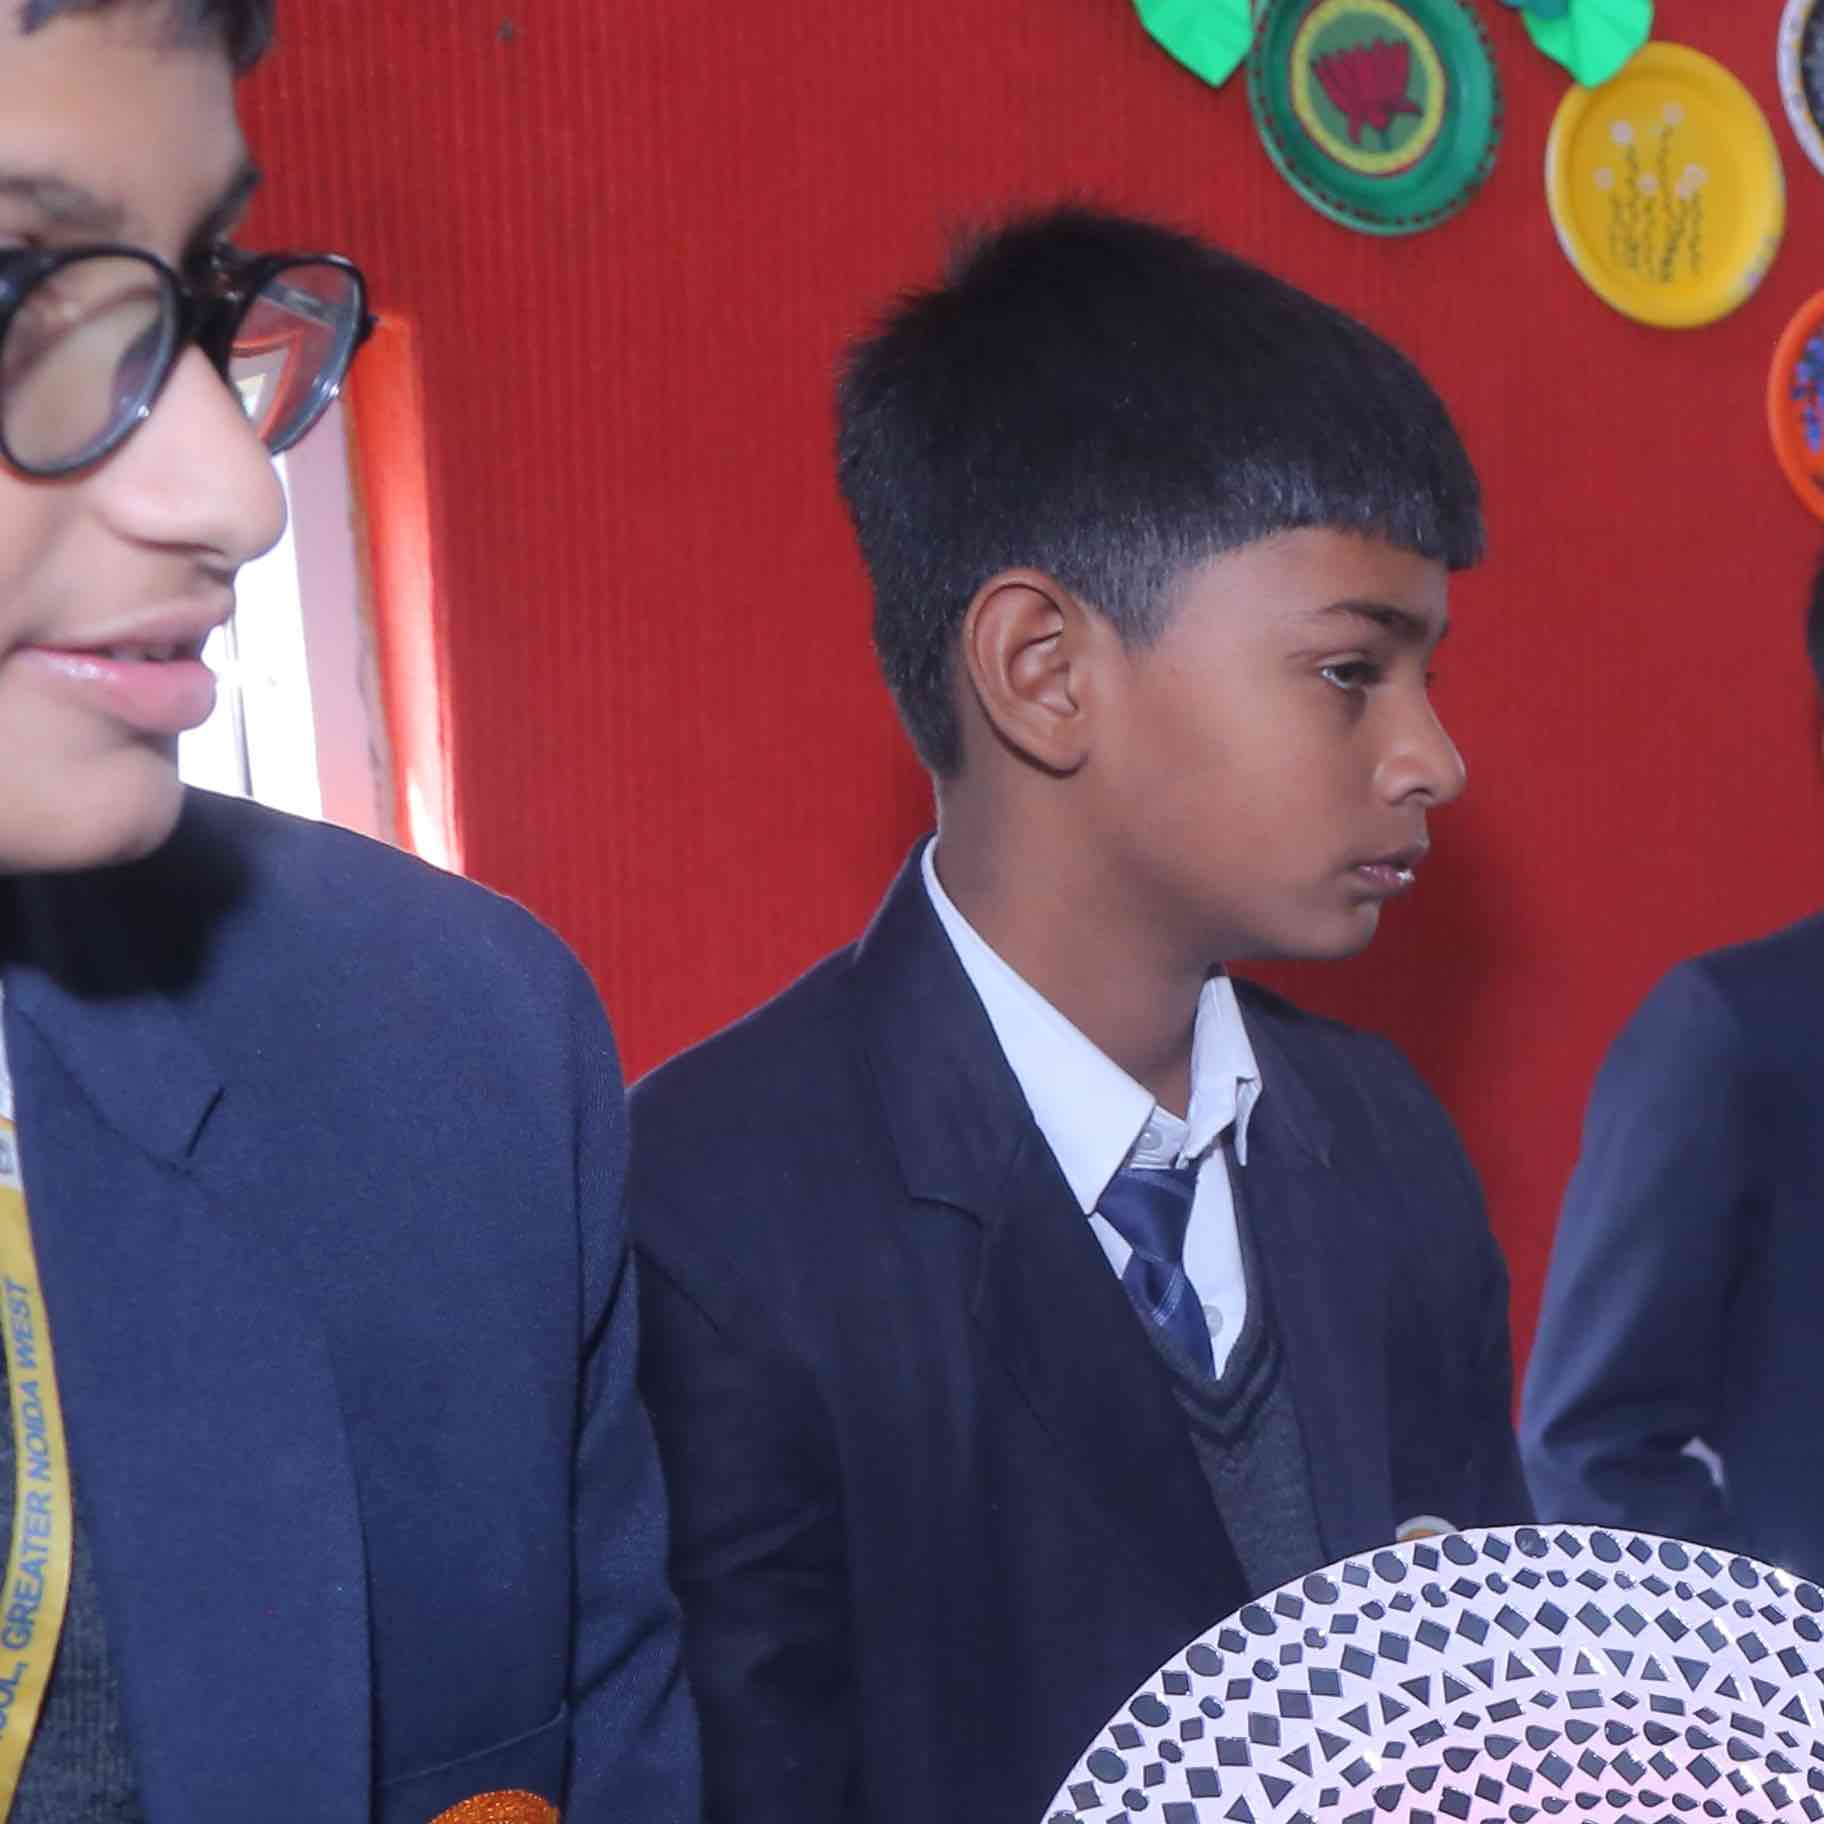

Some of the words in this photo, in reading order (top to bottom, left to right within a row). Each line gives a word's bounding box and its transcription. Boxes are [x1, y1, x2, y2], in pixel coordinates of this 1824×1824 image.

[4, 1276, 39, 1369] WEST
[20, 1378, 51, 1482] NOIDA
[1, 1490, 52, 1651] GREATER
